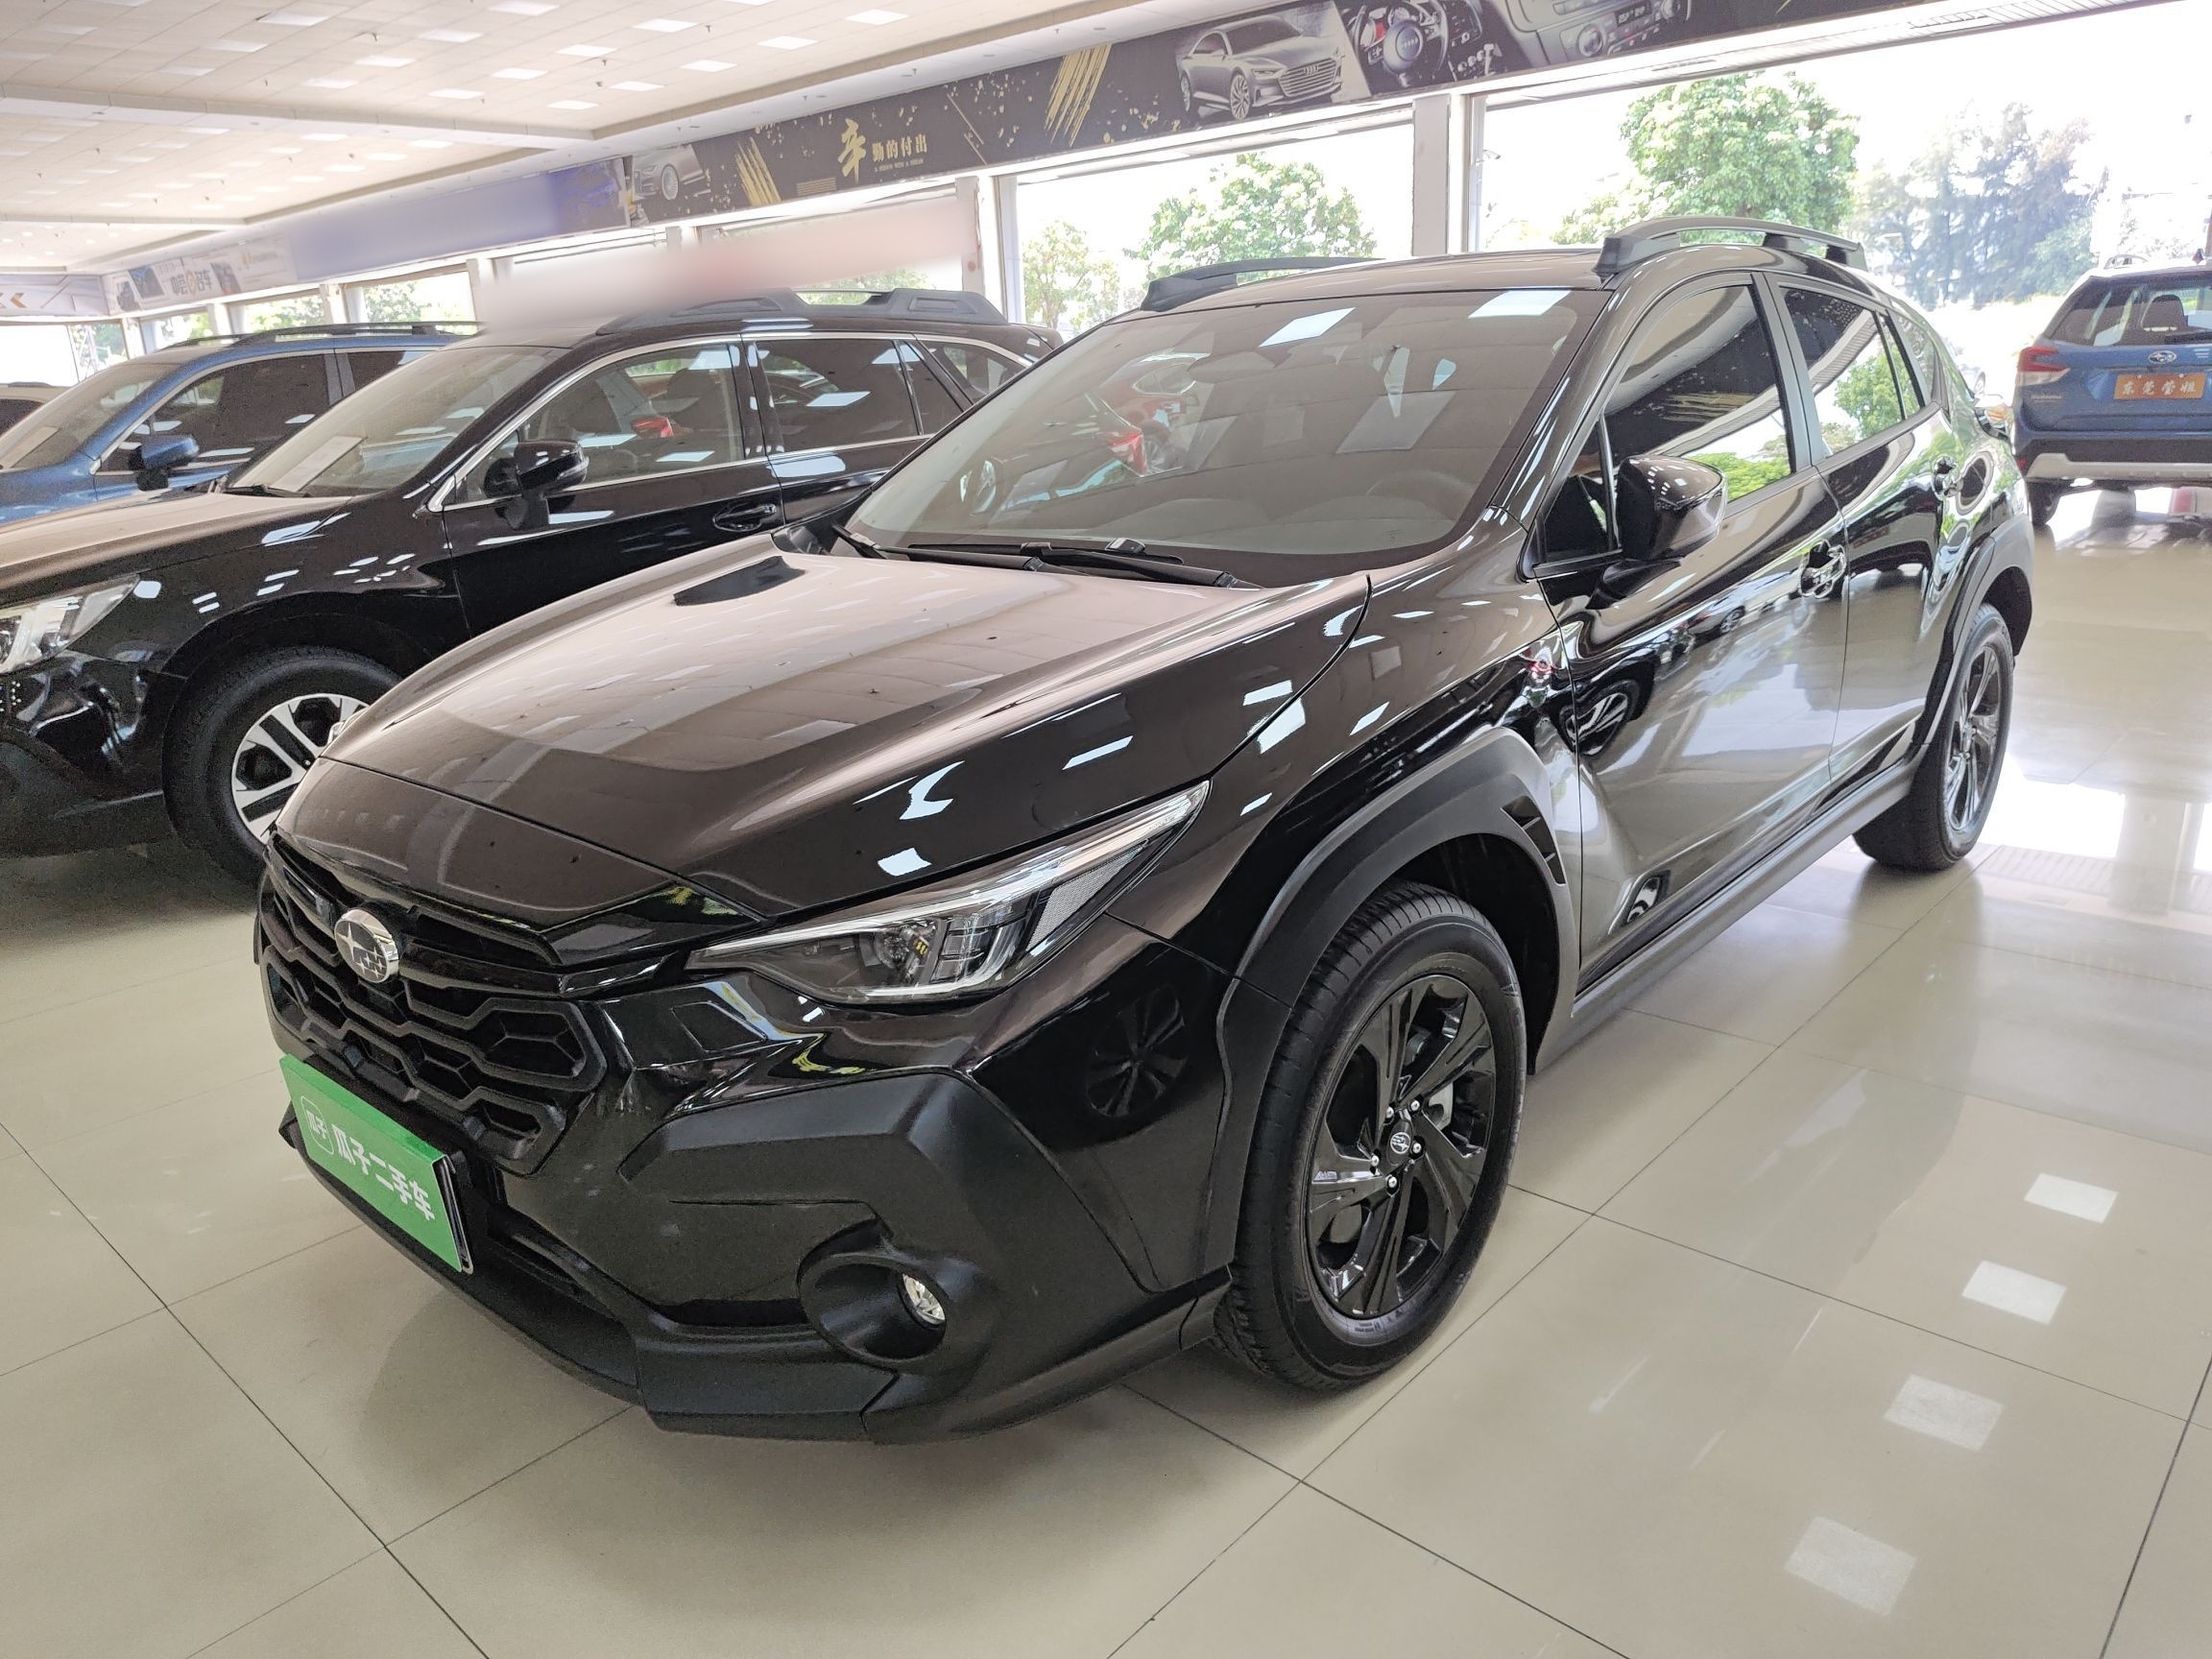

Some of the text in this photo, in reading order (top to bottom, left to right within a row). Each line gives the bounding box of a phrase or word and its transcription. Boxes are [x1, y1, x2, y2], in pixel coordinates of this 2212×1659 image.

[331, 1123, 436, 1221] 瓜子二手车
